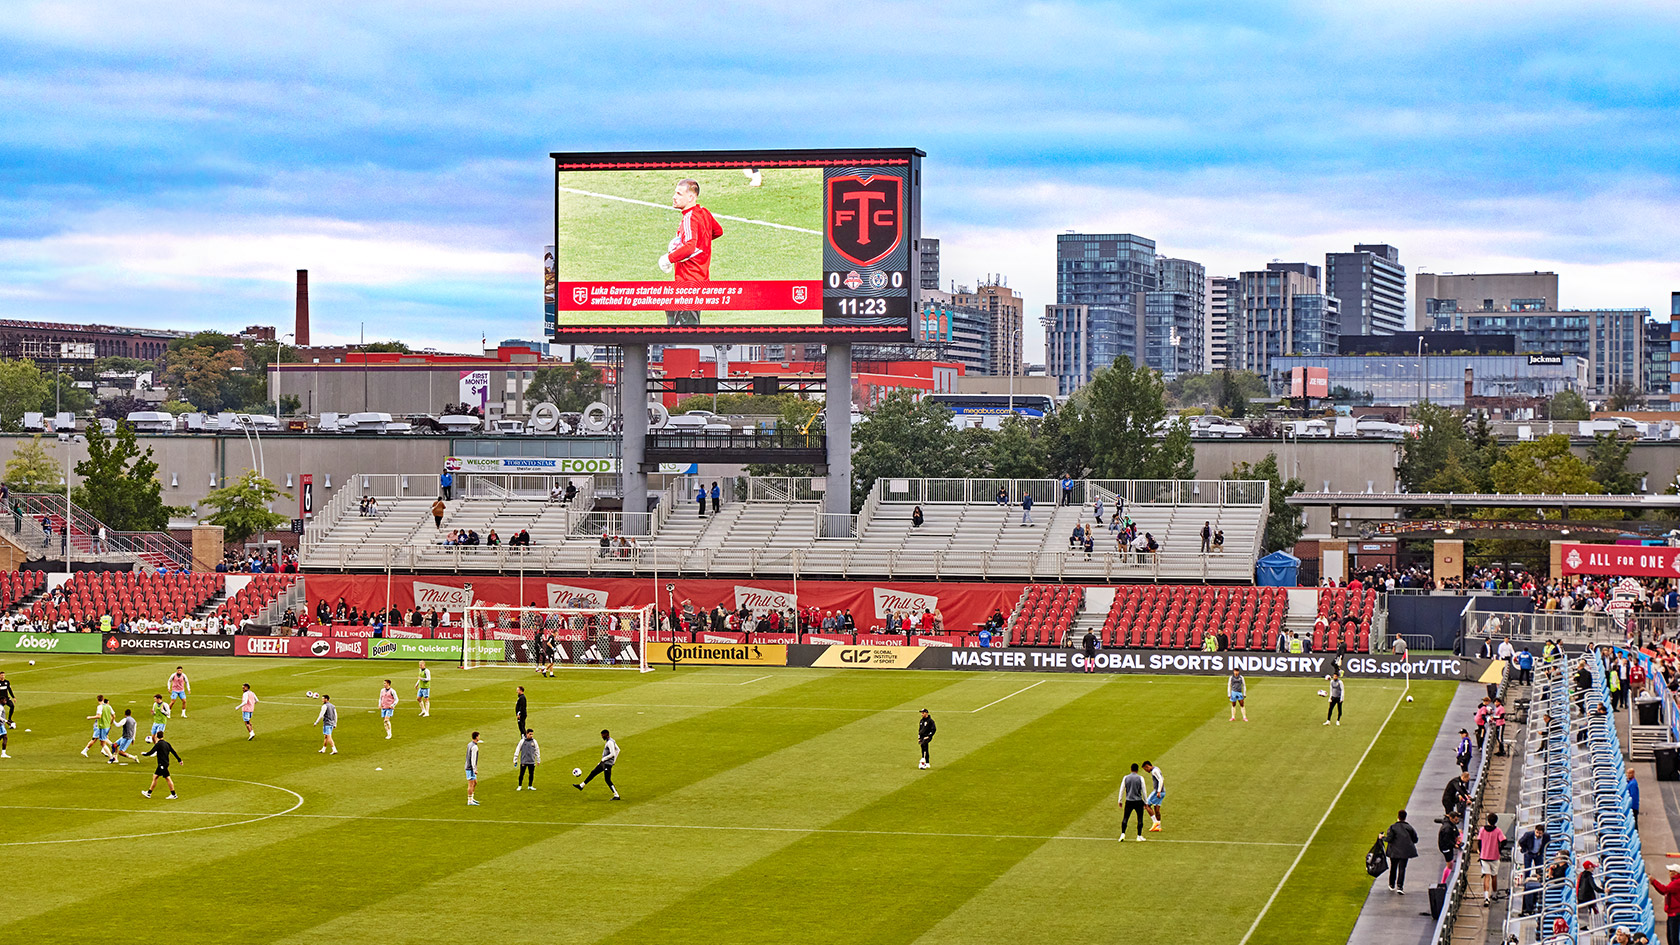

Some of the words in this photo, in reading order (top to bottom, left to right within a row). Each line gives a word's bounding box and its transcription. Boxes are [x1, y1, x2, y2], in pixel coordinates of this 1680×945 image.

[829, 272, 841, 288] 0
[891, 272, 903, 288] 0
[591, 286, 608, 295] Luka
[609, 286, 634, 295] Gavran
[636, 286, 662, 295] started
[663, 286, 674, 295] his
[675, 287, 700, 295] soccer
[702, 286, 726, 295] career
[591, 296, 622, 305] switched
[624, 296, 631, 305] to
[632, 296, 673, 306] goalkeeper
[674, 296, 693, 304] when
[694, 296, 703, 304] he
[721, 296, 730, 304] 13
[838, 299, 887, 315] 11:23
[1530, 355, 1560, 364] Jackman
[963, 407, 1010, 416] megabus.com
[561, 459, 611, 472] FOOD
[305, 484, 311, 511] 6
[1589, 553, 1611, 567] ALL
[1617, 556, 1634, 566] FOR
[1640, 555, 1664, 569] ONE
[419, 588, 449, 602] Mill
[450, 591, 466, 603] St.
[740, 593, 772, 606] Mill
[772, 596, 789, 608] St.
[880, 595, 911, 609] Mill
[15, 634, 59, 650] Sobeys
[120, 639, 190, 649] POKERSTARS
[192, 640, 231, 649] CASINO
[335, 640, 361, 654] PRINGLES
[372, 642, 397, 657] Bounty
[402, 644, 416, 652] The
[418, 645, 448, 653] Quicker
[478, 646, 502, 654] Upper
[667, 644, 749, 662] Continental
[840, 649, 871, 664] GIS
[951, 651, 1026, 667] MASTER
[1031, 653, 1067, 667] THE
[1150, 655, 1224, 670] SPORTS
[1228, 656, 1325, 673] INDUSTRY
[1347, 658, 1461, 676] GIS.sport/TFC
